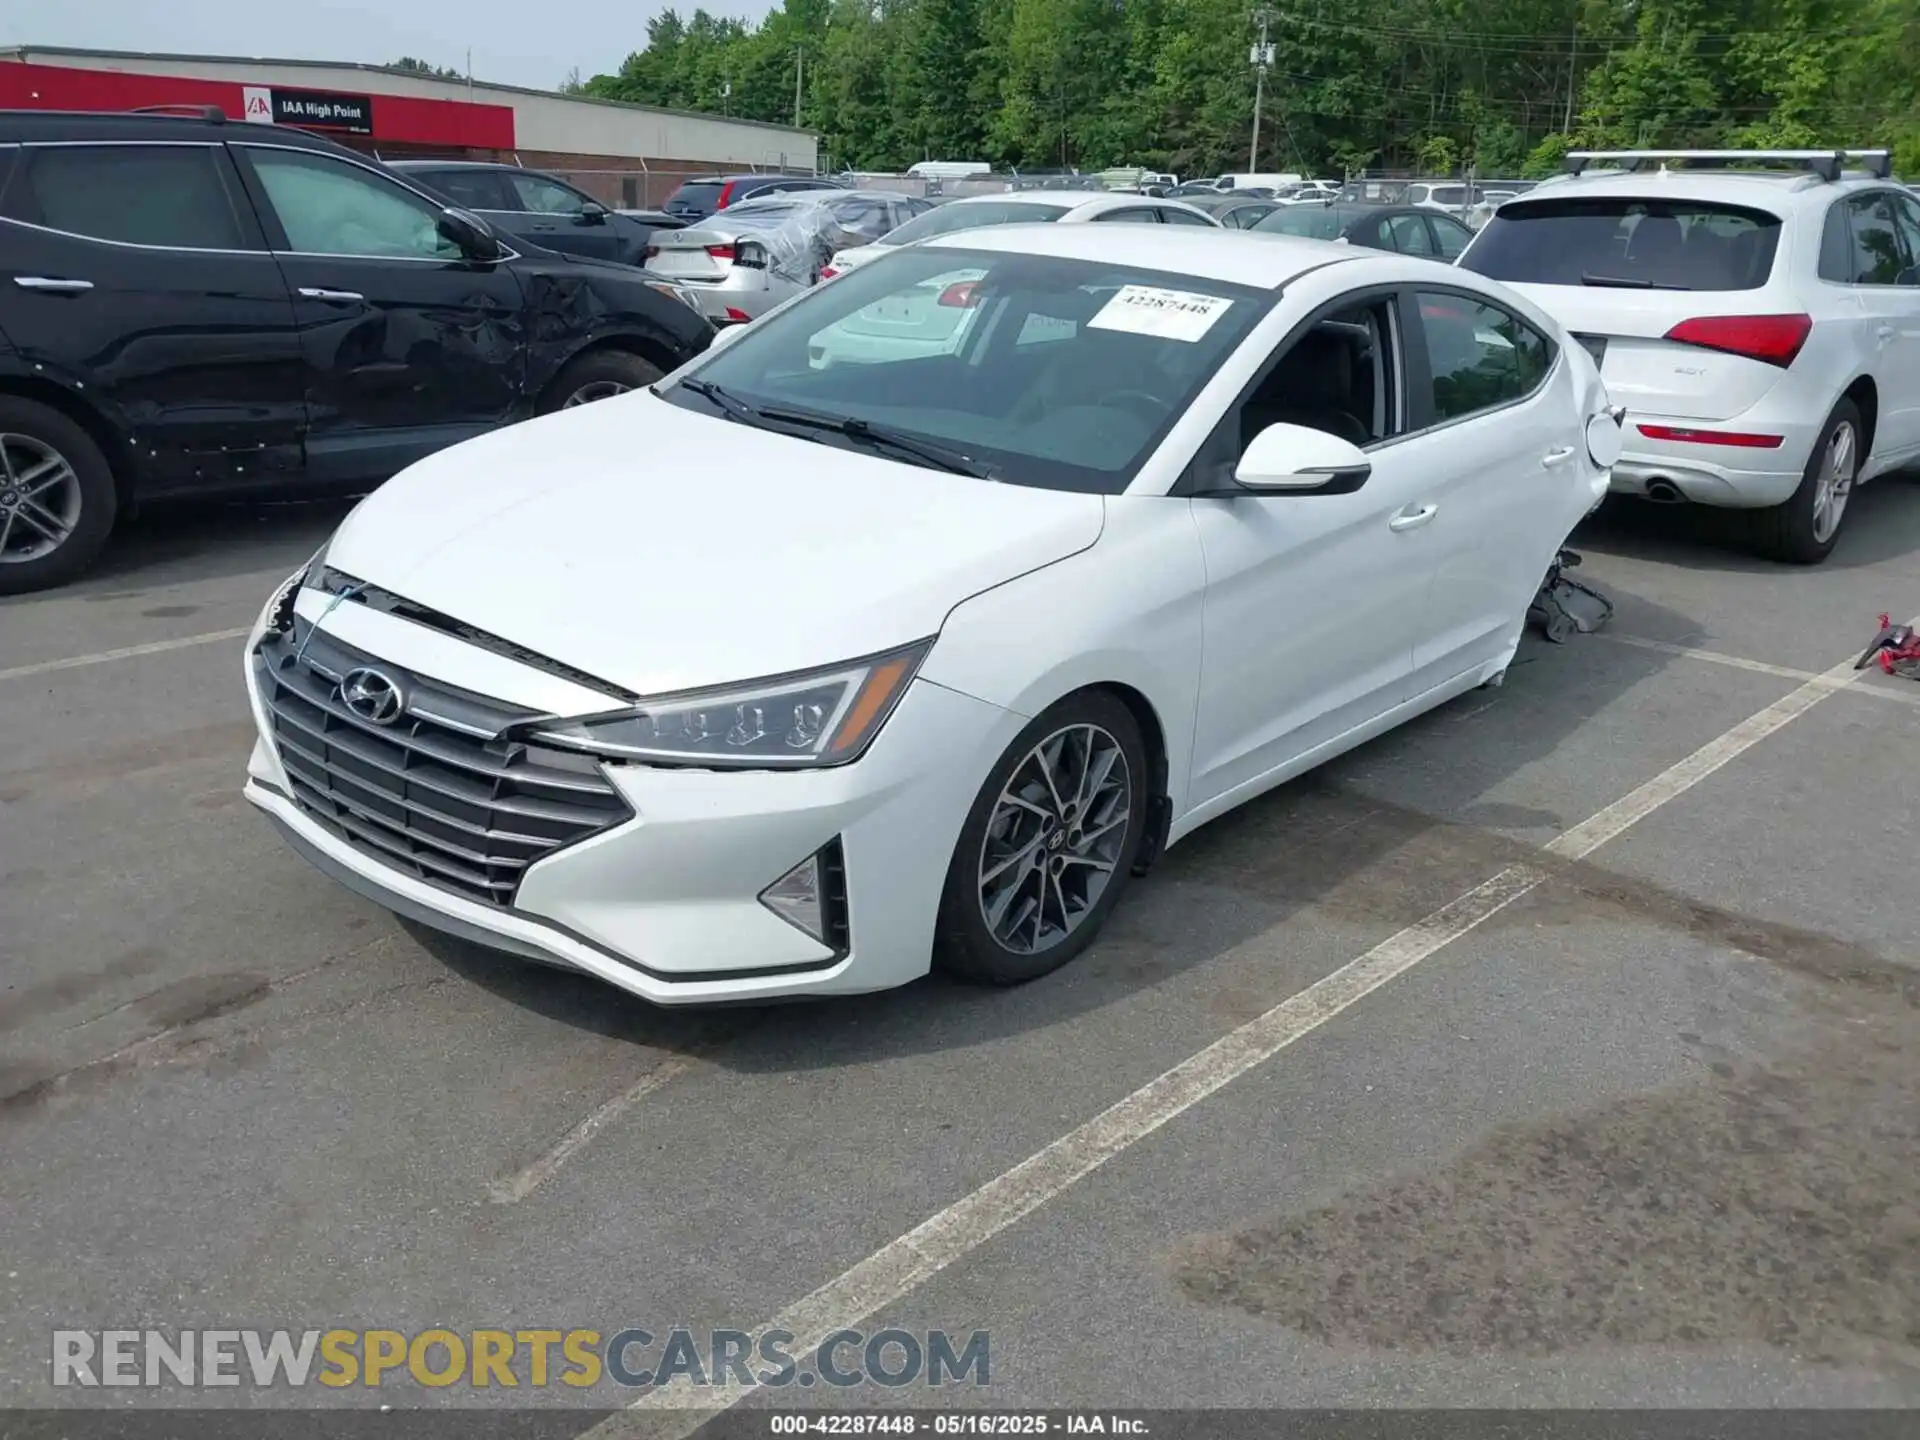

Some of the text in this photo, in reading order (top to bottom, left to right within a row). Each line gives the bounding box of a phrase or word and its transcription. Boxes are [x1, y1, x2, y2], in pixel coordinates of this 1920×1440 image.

[282, 100, 361, 118] IAA High Point
[1122, 295, 1211, 315] 42287448
